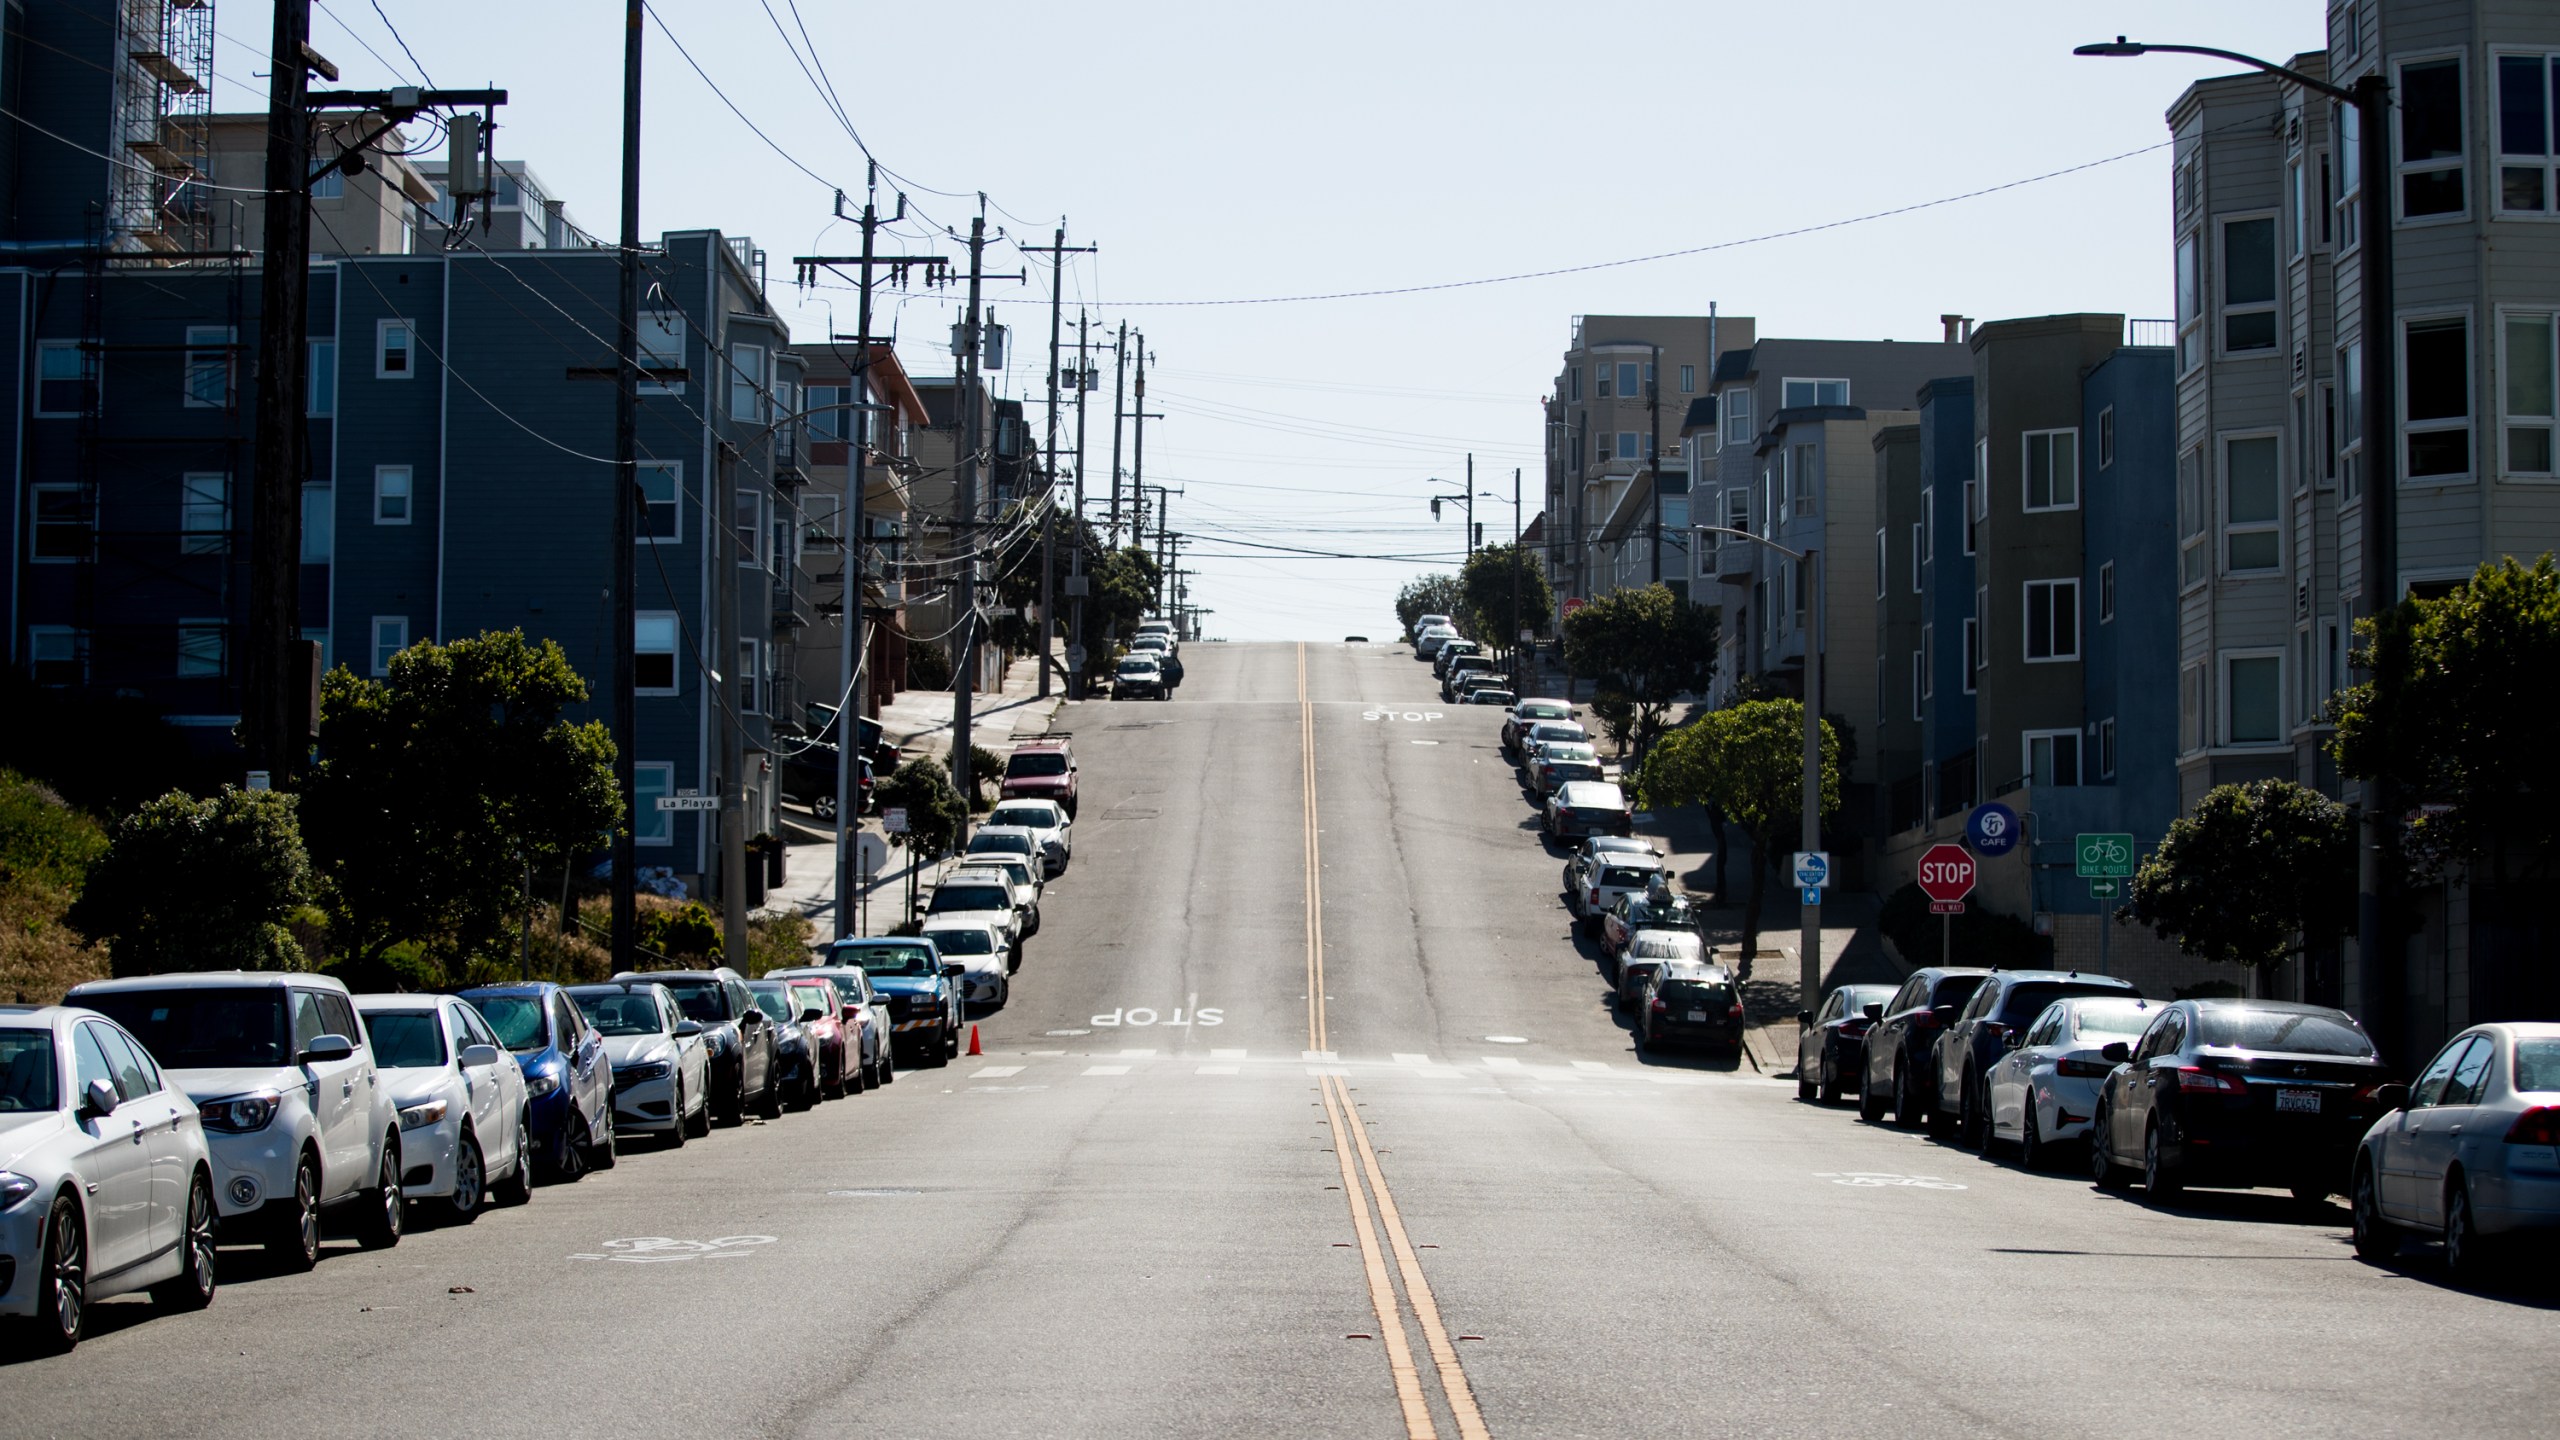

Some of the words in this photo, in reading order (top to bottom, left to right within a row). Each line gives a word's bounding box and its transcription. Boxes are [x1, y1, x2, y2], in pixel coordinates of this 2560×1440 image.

[1362, 711, 1443, 721] STOP
[663, 800, 676, 808] La
[681, 799, 713, 809] Playa
[1980, 838, 2007, 846] CAFE
[1922, 862, 1972, 884] STOP
[2081, 865, 2099, 874] BIKE
[2103, 865, 2128, 874] ROUTE
[1090, 1007, 1224, 1026] STOP
